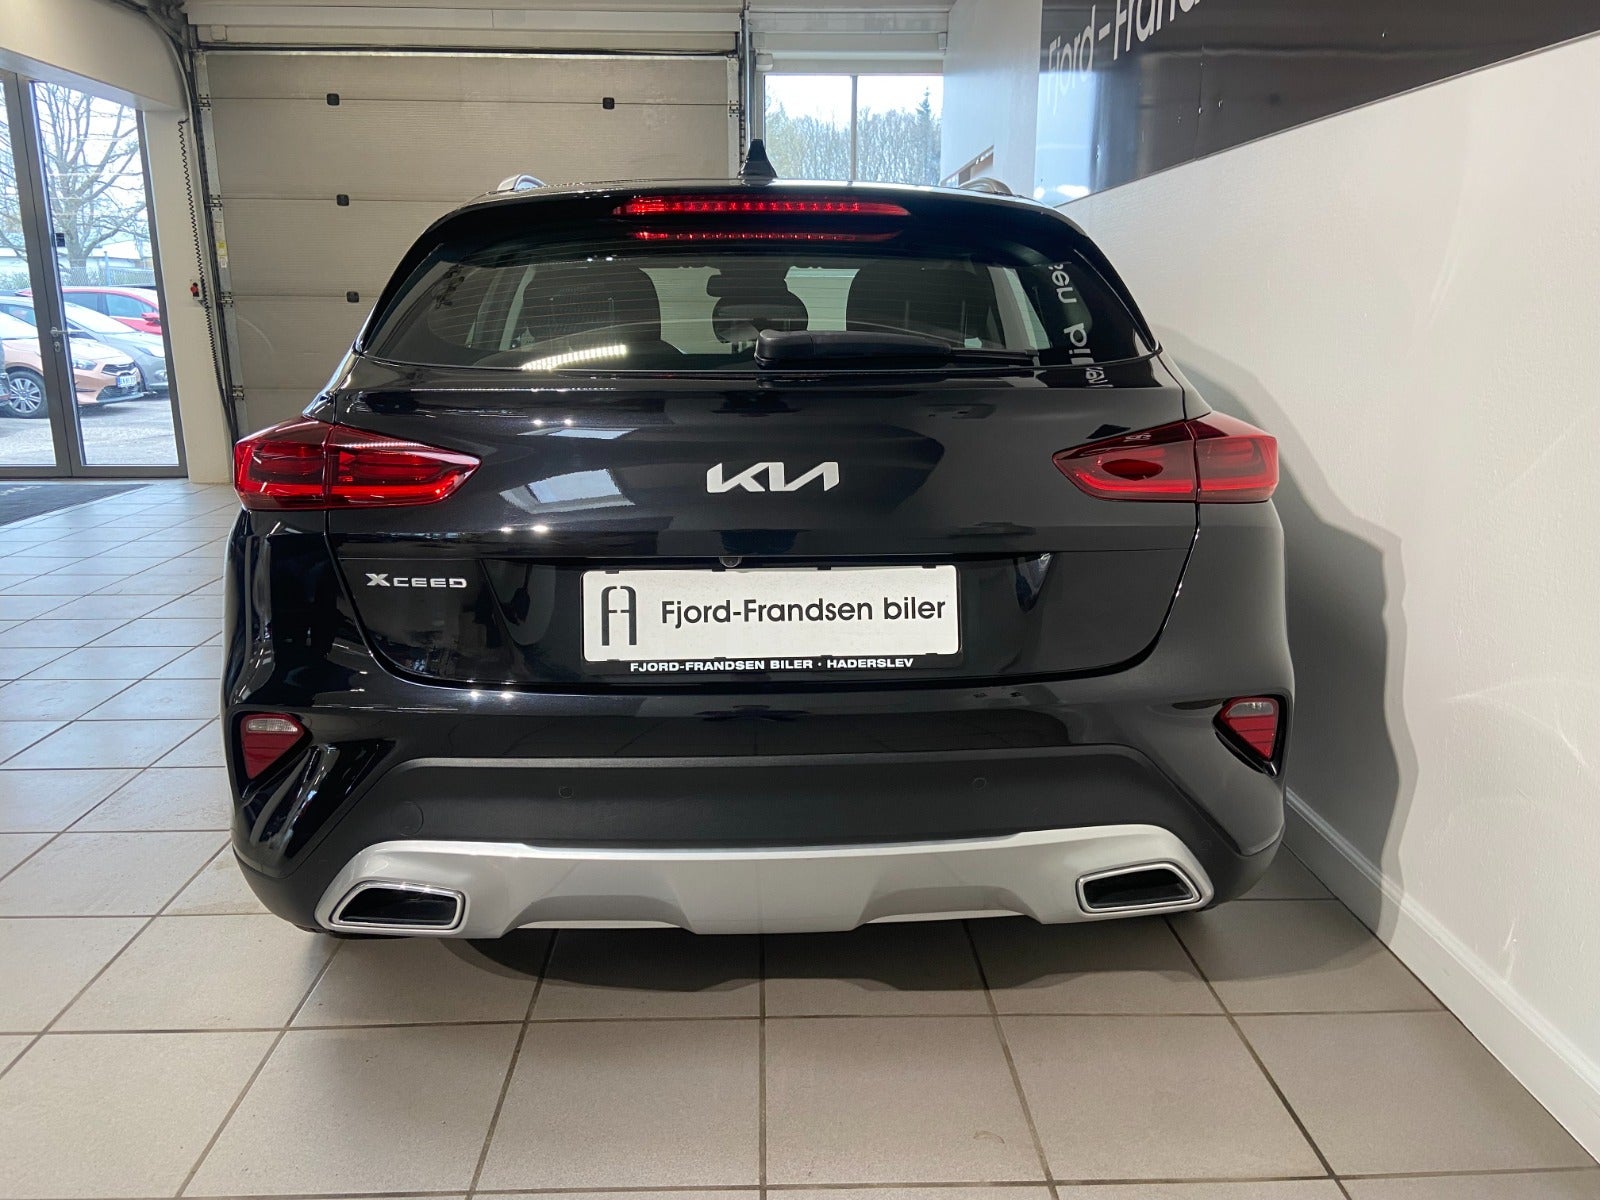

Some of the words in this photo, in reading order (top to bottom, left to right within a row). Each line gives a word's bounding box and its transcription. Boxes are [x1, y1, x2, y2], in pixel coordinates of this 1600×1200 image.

[706, 461, 840, 494] KIA
[365, 573, 468, 589] XCEED
[661, 598, 873, 629] Fjord-Frandsen
[883, 596, 946, 620] biler
[630, 660, 765, 672] FJORD-FRANDSEN
[769, 659, 813, 670] BILER
[826, 658, 914, 669] HADERSLEV
